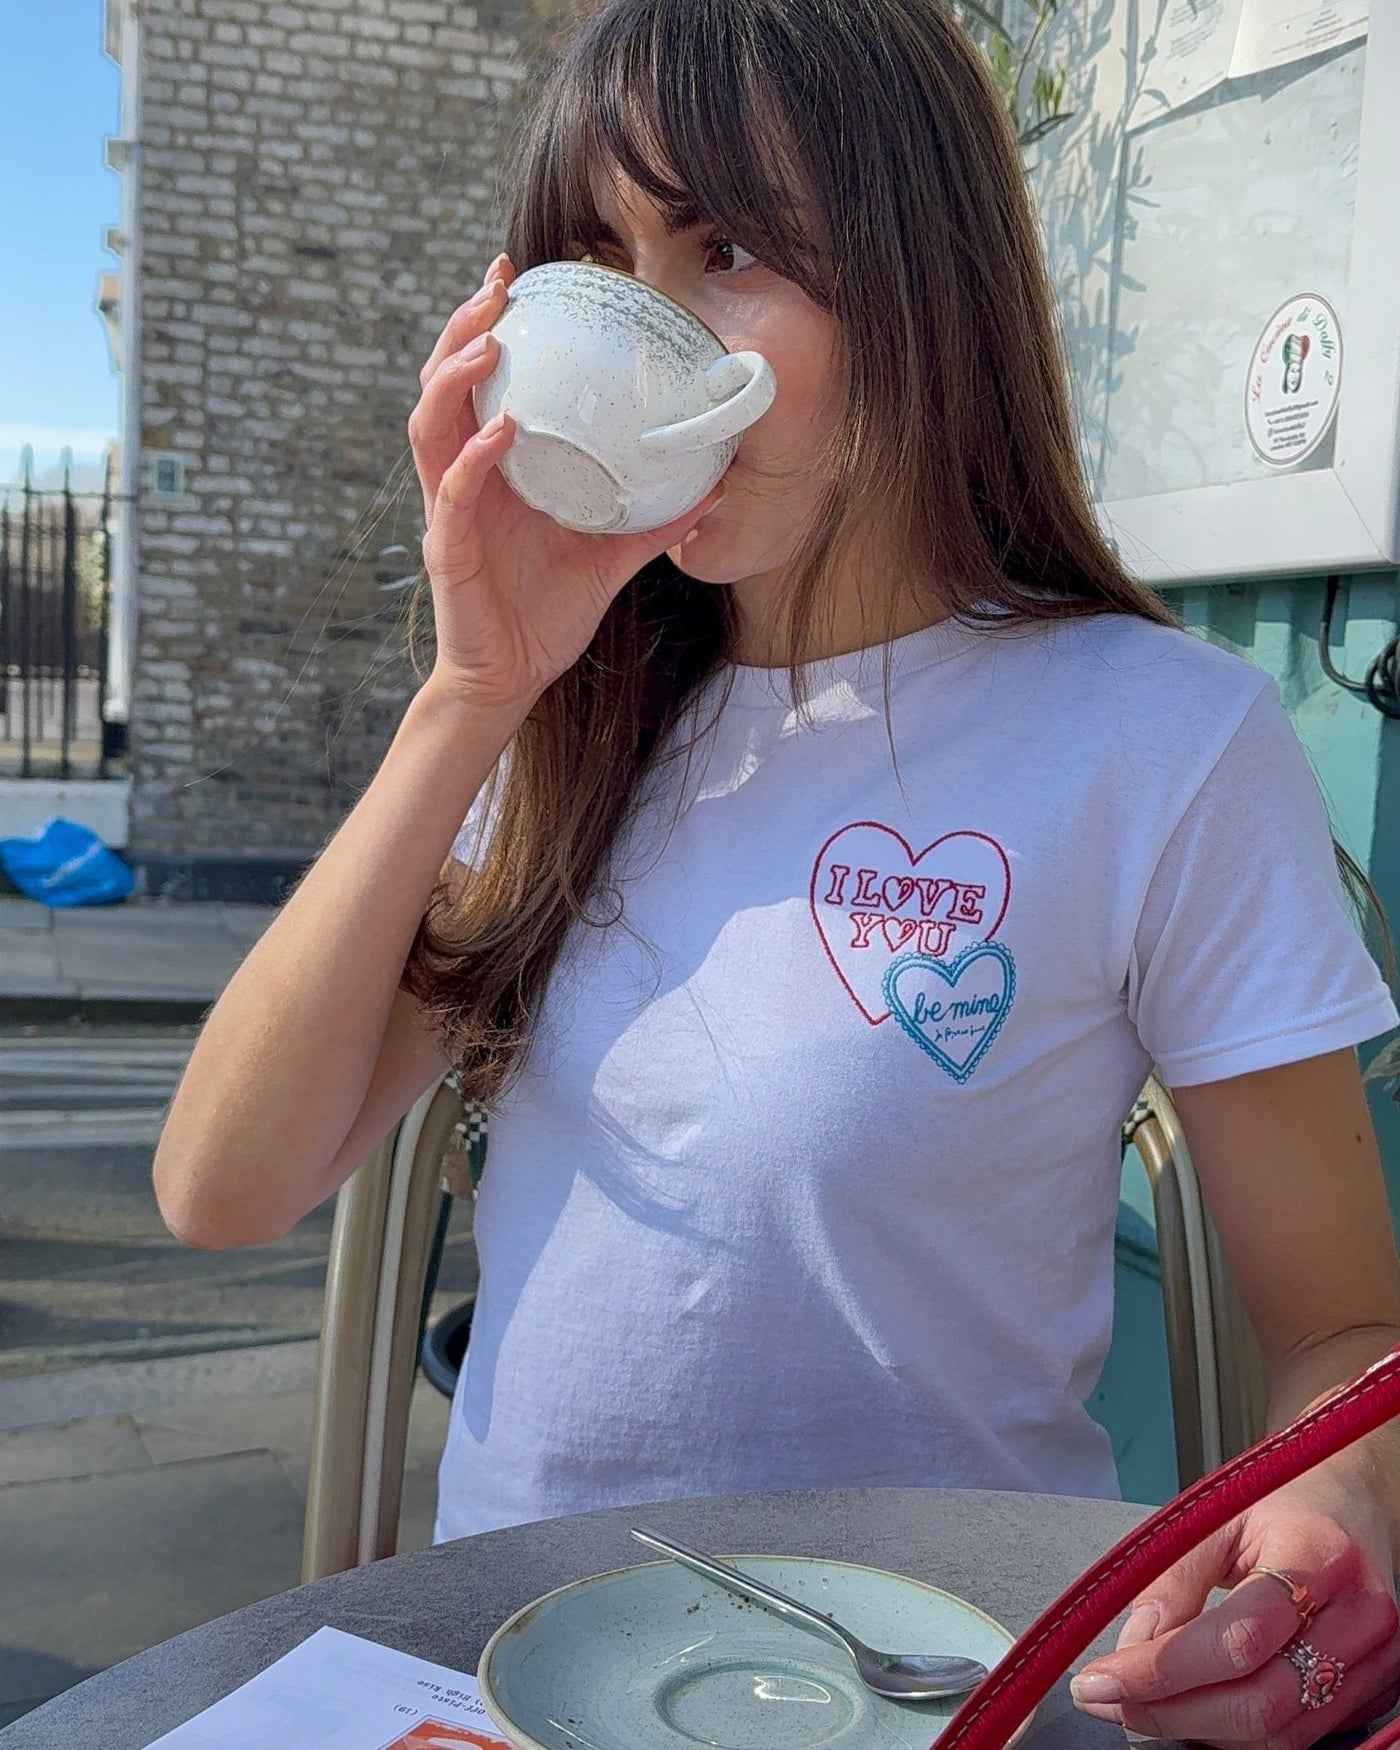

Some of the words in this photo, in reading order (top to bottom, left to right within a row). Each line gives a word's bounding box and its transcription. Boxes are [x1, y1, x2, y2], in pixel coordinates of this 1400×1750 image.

[1312, 313, 1335, 359] Daffy
[825, 865, 850, 905] I
[851, 869, 986, 924] LOVE
[849, 912, 956, 957] YOU
[913, 992, 944, 1024] be
[946, 993, 1000, 1020] mine
[417, 1679, 442, 1692] Rise
[446, 1688, 472, 1702] High
[393, 1704, 418, 1716] (19)
[431, 1694, 486, 1715] Off-Piste
